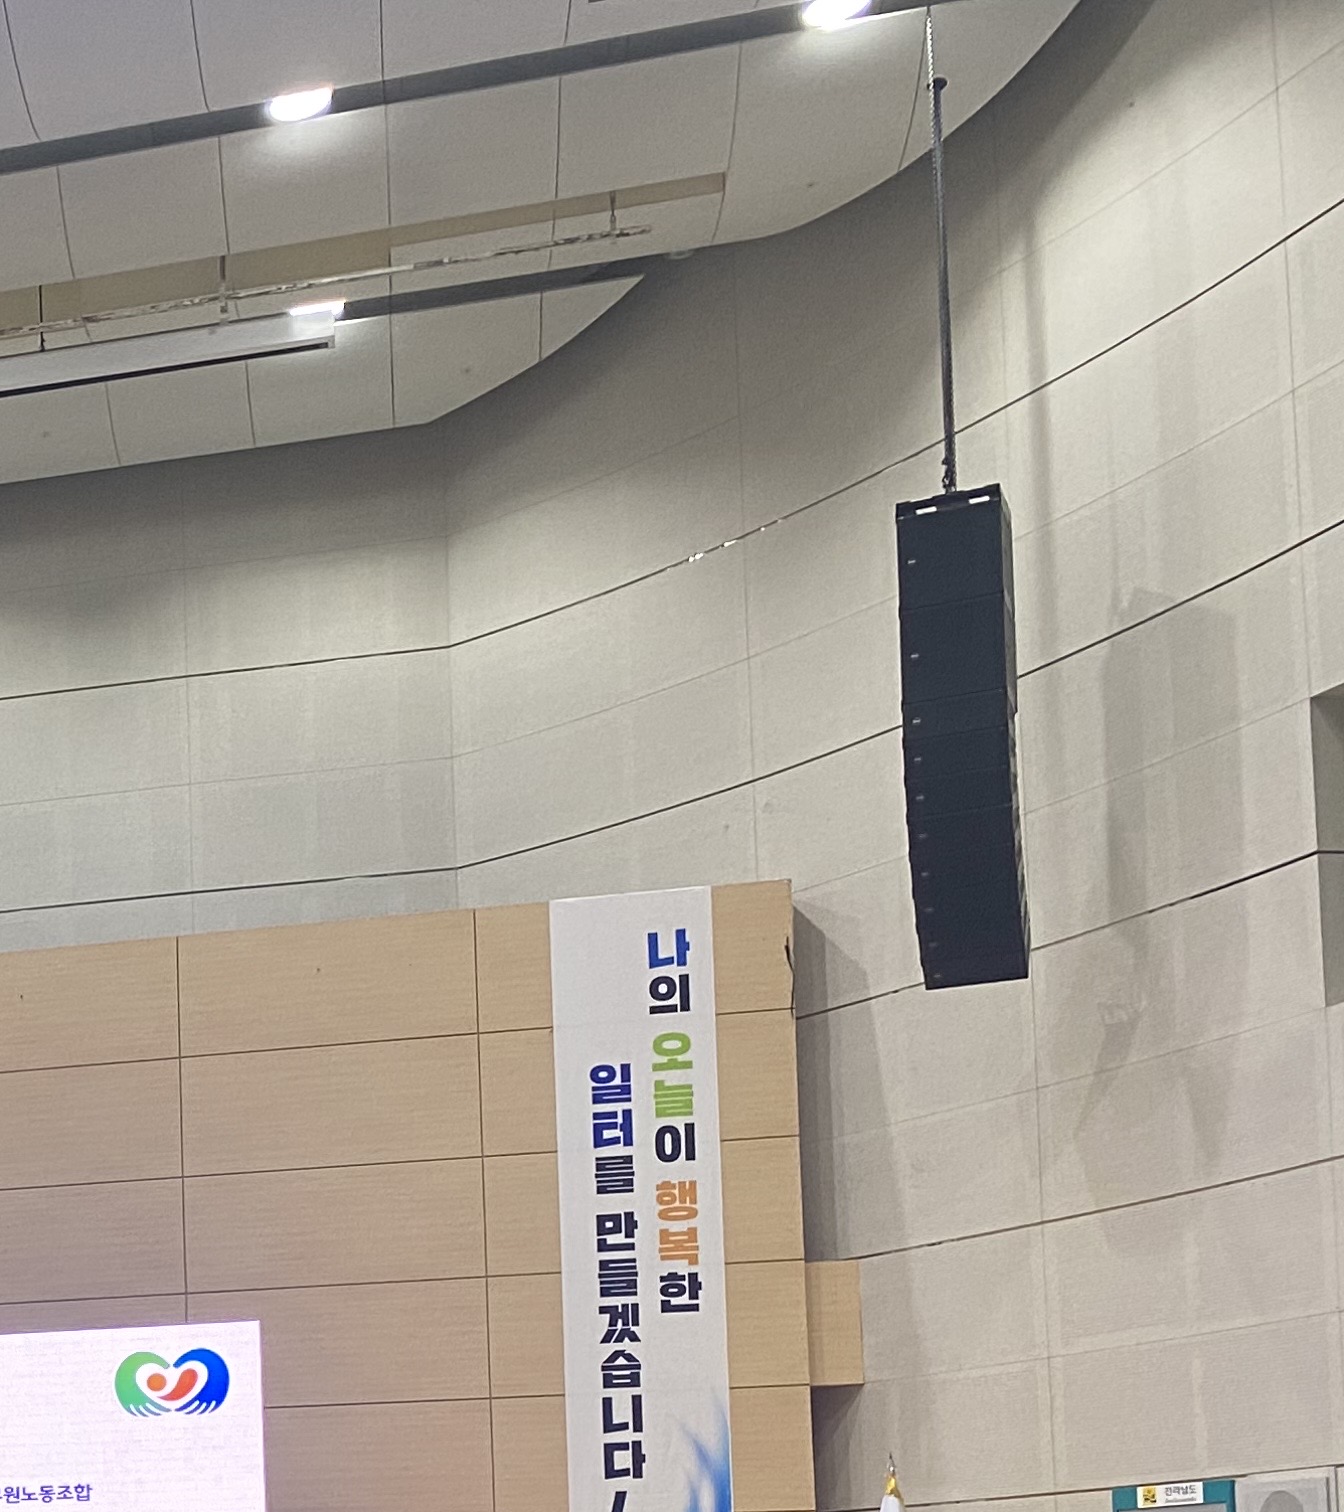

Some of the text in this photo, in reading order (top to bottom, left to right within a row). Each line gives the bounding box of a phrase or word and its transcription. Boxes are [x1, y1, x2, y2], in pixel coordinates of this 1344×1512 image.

[589, 1062, 635, 1195] 일터를
[646, 928, 702, 1314] 나의 오늘이 행복한
[1165, 1484, 1197, 1497] 전라남도
